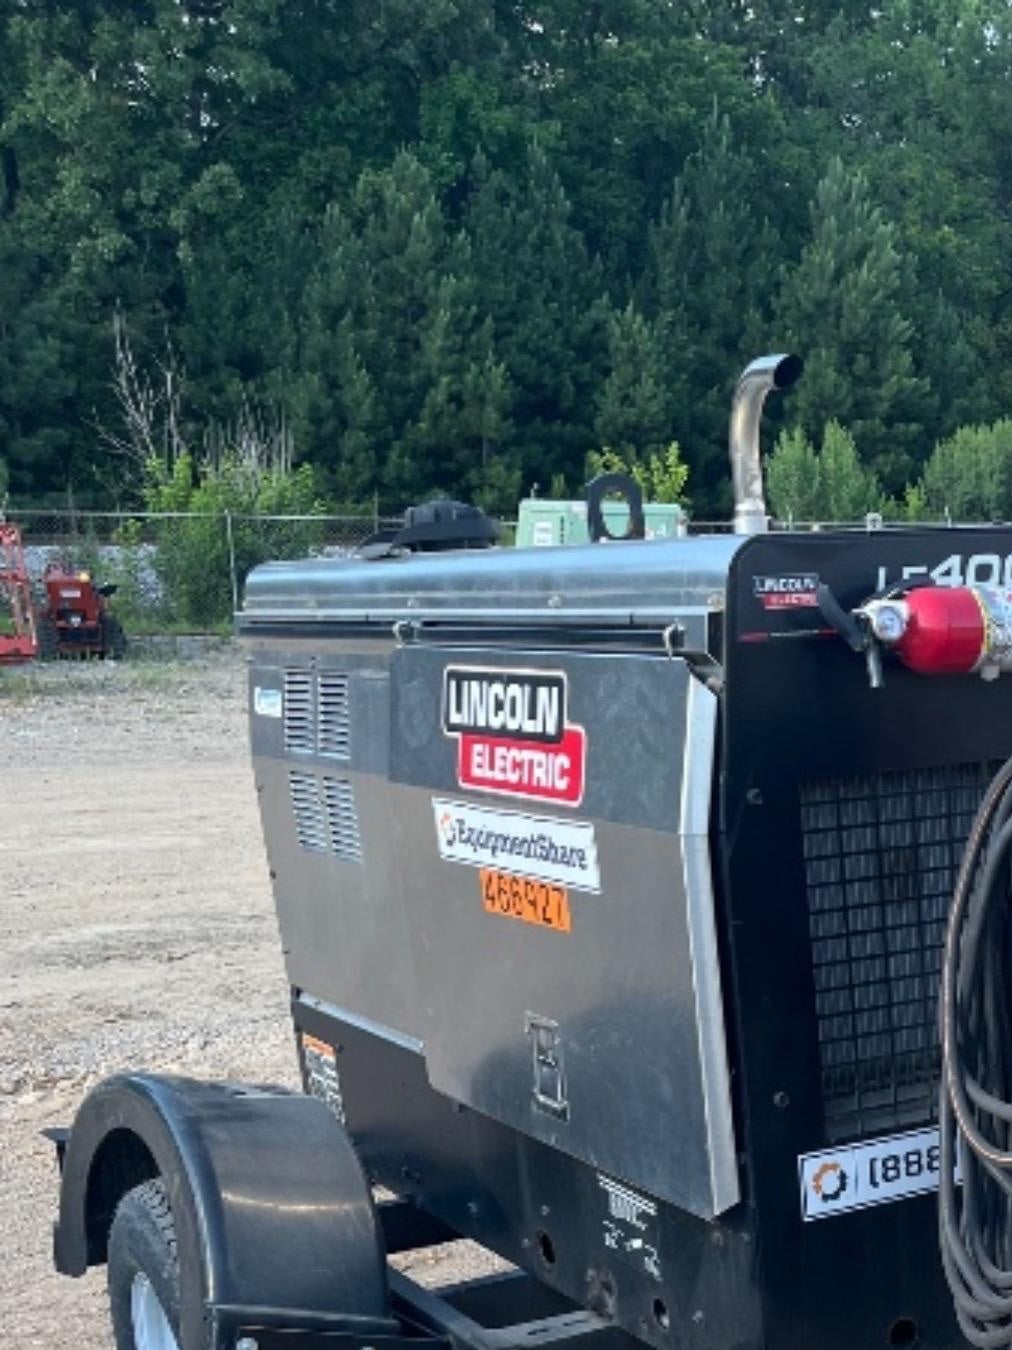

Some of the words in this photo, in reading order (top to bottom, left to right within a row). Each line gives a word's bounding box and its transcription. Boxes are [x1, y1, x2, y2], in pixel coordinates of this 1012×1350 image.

[449, 679, 559, 735] LINCOLN
[470, 743, 571, 790] ELECTRIC
[455, 818, 588, 870] EquipmentShare
